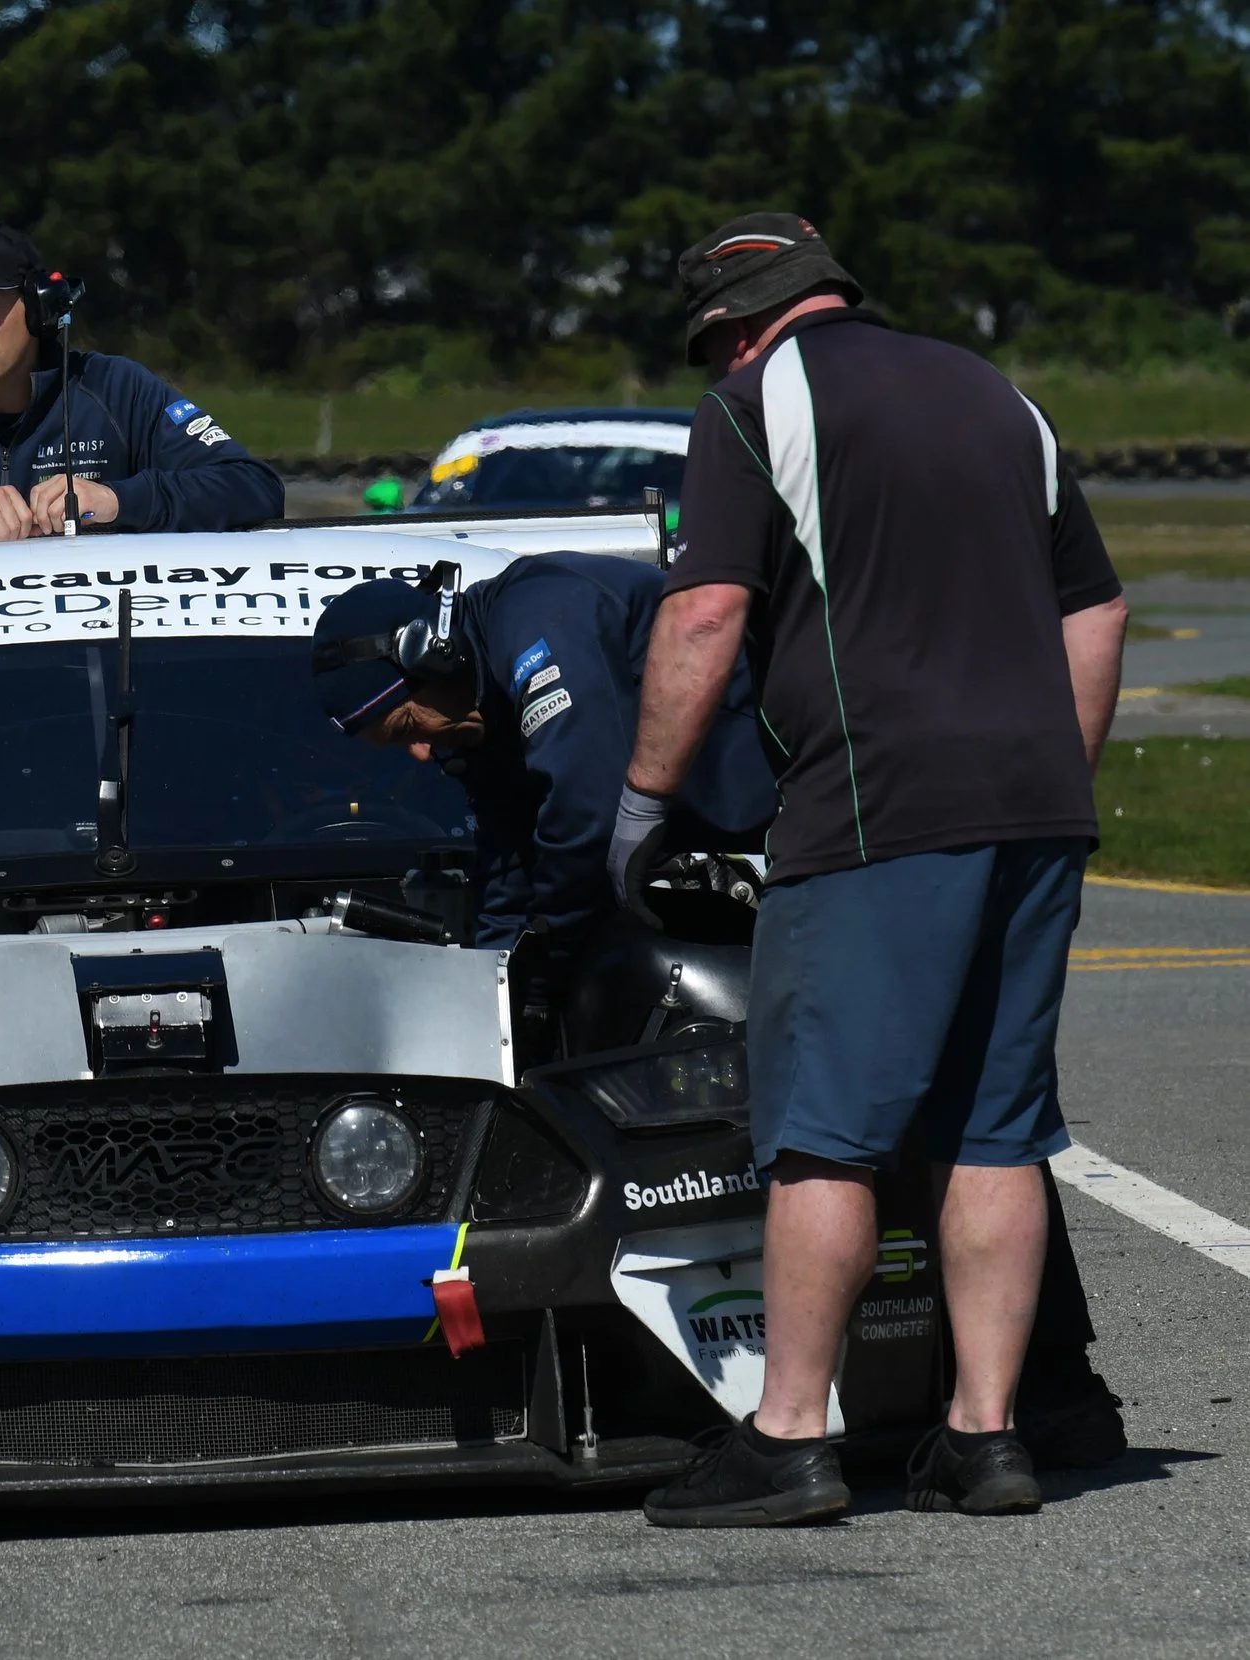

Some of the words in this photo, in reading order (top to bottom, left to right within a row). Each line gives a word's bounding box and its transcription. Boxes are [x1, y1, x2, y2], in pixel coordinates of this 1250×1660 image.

[70, 440, 105, 453] CRISP
[269, 562, 431, 581] Ford
[530, 649, 544, 664] Day
[521, 693, 568, 731] WATSON
[43, 1138, 283, 1192] MARC
[623, 1163, 760, 1210] Southland
[861, 1296, 934, 1318] SOUTHLAND
[861, 1320, 924, 1341] CONCRETE
[698, 1346, 741, 1361] Farm
